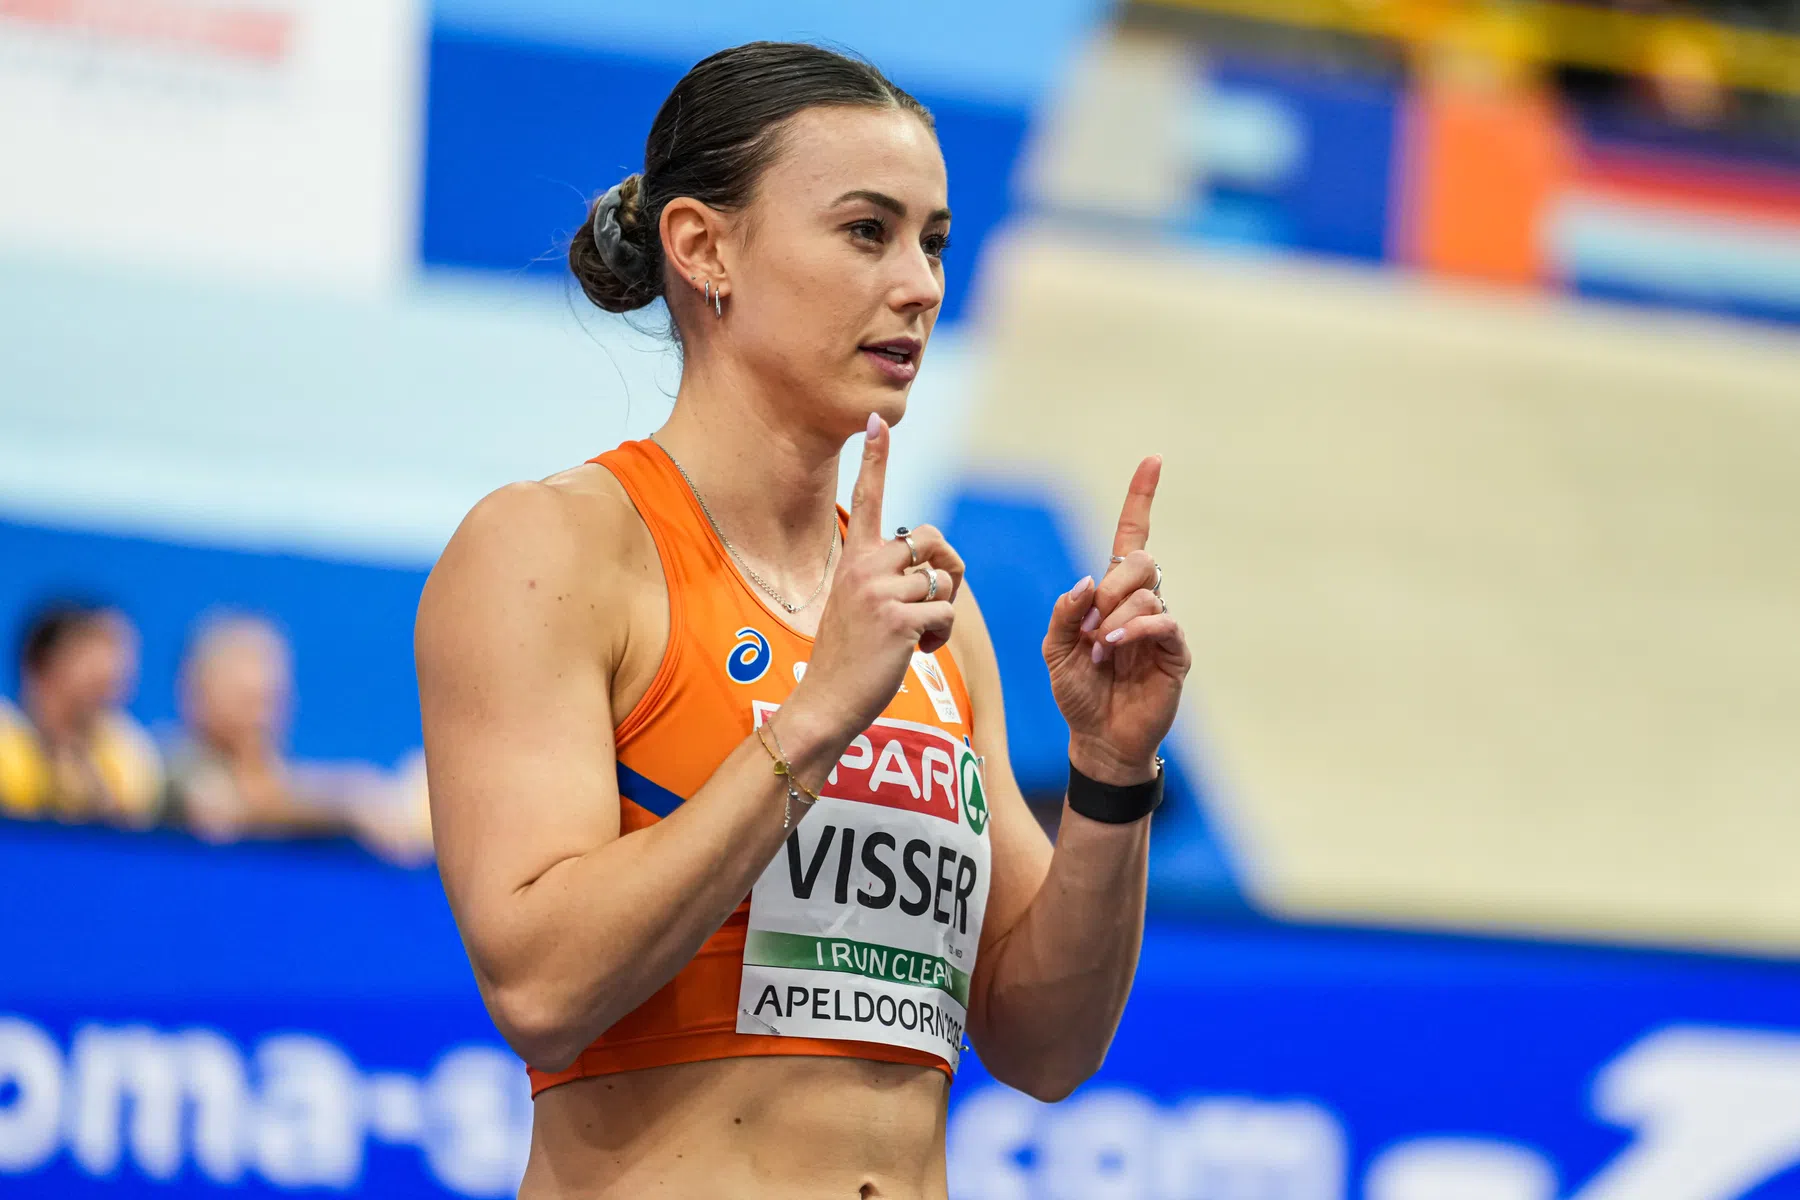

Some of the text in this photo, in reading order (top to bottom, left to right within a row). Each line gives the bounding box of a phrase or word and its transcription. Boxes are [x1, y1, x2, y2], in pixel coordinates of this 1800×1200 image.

[828, 734, 956, 810] PAR
[787, 825, 977, 934] VISSER
[816, 941, 953, 990] I RUN CLEAN
[753, 984, 944, 1039] APELDOORN
